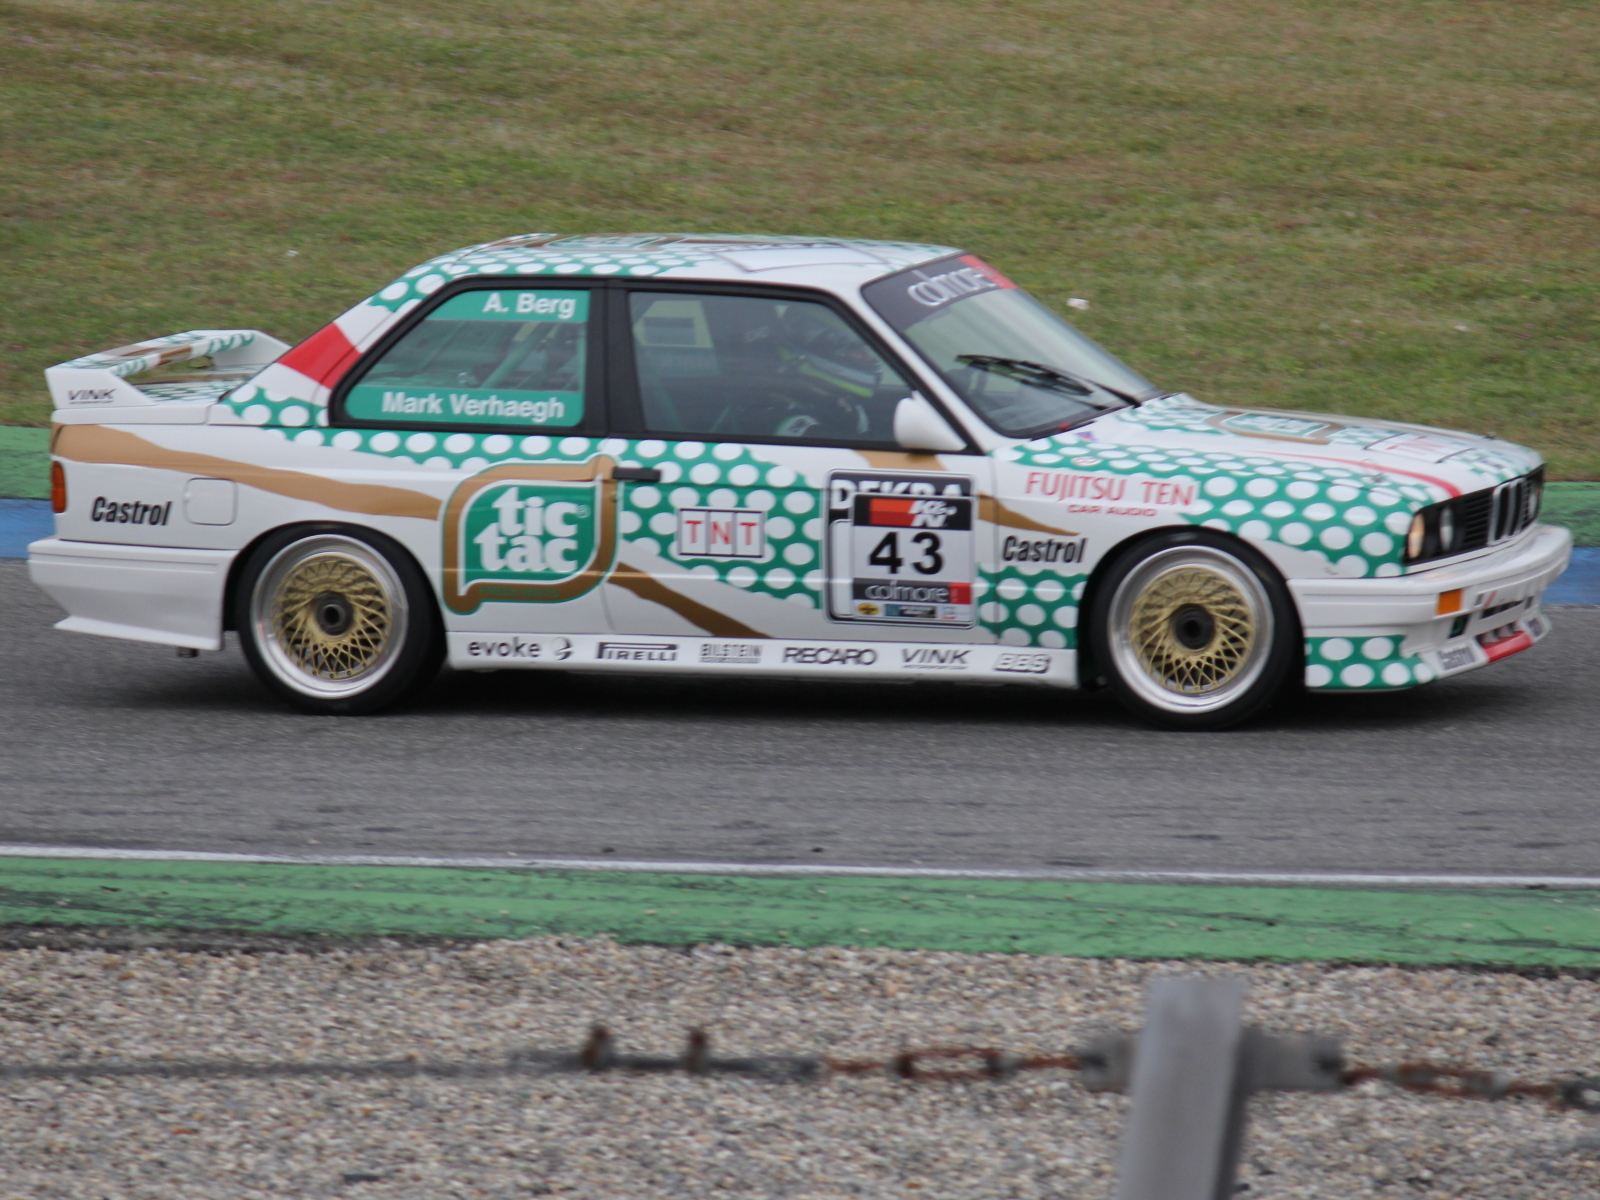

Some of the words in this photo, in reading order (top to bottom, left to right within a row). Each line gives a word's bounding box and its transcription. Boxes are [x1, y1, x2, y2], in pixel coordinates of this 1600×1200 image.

[483, 293, 509, 313] A.
[516, 293, 577, 319] Berg
[67, 388, 116, 400] VINK
[381, 391, 443, 414] Mark
[450, 394, 565, 423] Verhaegh
[1025, 472, 1128, 502] FUJITSU
[1141, 481, 1196, 506] TEN
[92, 496, 173, 526] Castrol
[491, 487, 578, 537] tic
[1067, 504, 1102, 514] CAR
[1106, 506, 1158, 517] AUDIO
[684, 520, 759, 546] TNT
[473, 523, 578, 573] tac
[868, 532, 944, 575] 43
[1003, 535, 1089, 565] Castrol
[865, 579, 949, 603] colmore
[467, 637, 542, 657] evoke
[595, 642, 678, 661] PIRELLI
[701, 643, 763, 657] BILSTEIN
[782, 647, 877, 665] RECARO
[902, 648, 973, 664] VINK
